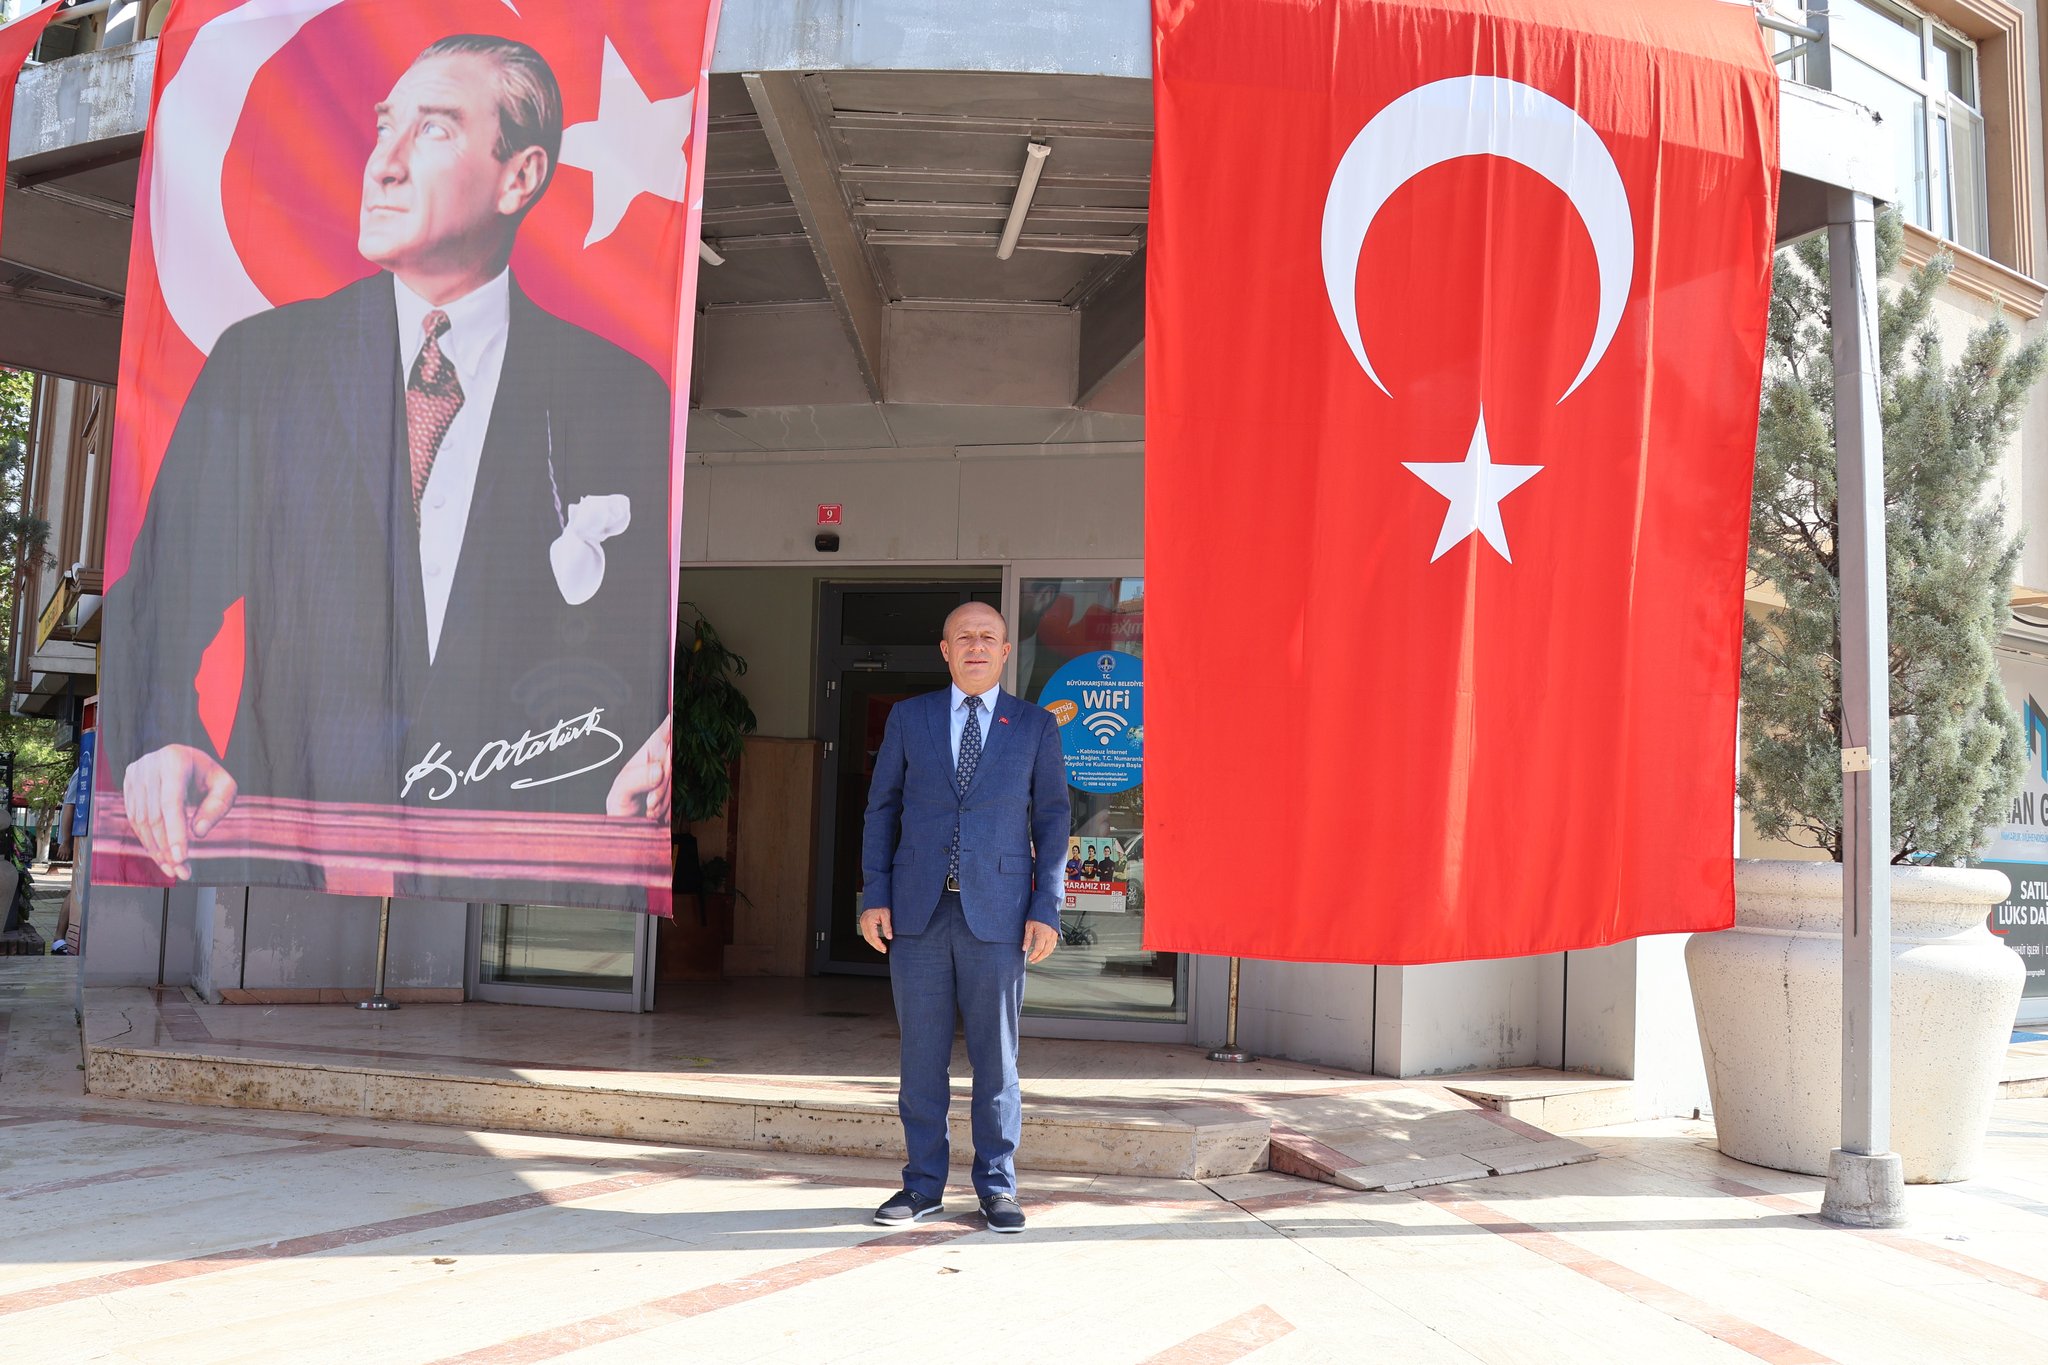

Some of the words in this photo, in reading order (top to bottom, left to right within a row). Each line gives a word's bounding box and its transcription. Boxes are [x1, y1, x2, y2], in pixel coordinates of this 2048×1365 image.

[827, 510, 833, 520] 9
[1082, 689, 1130, 710] WiFi
[1050, 702, 1074, 715] RETSİZ
[1999, 901, 2028, 925] LÜKS
